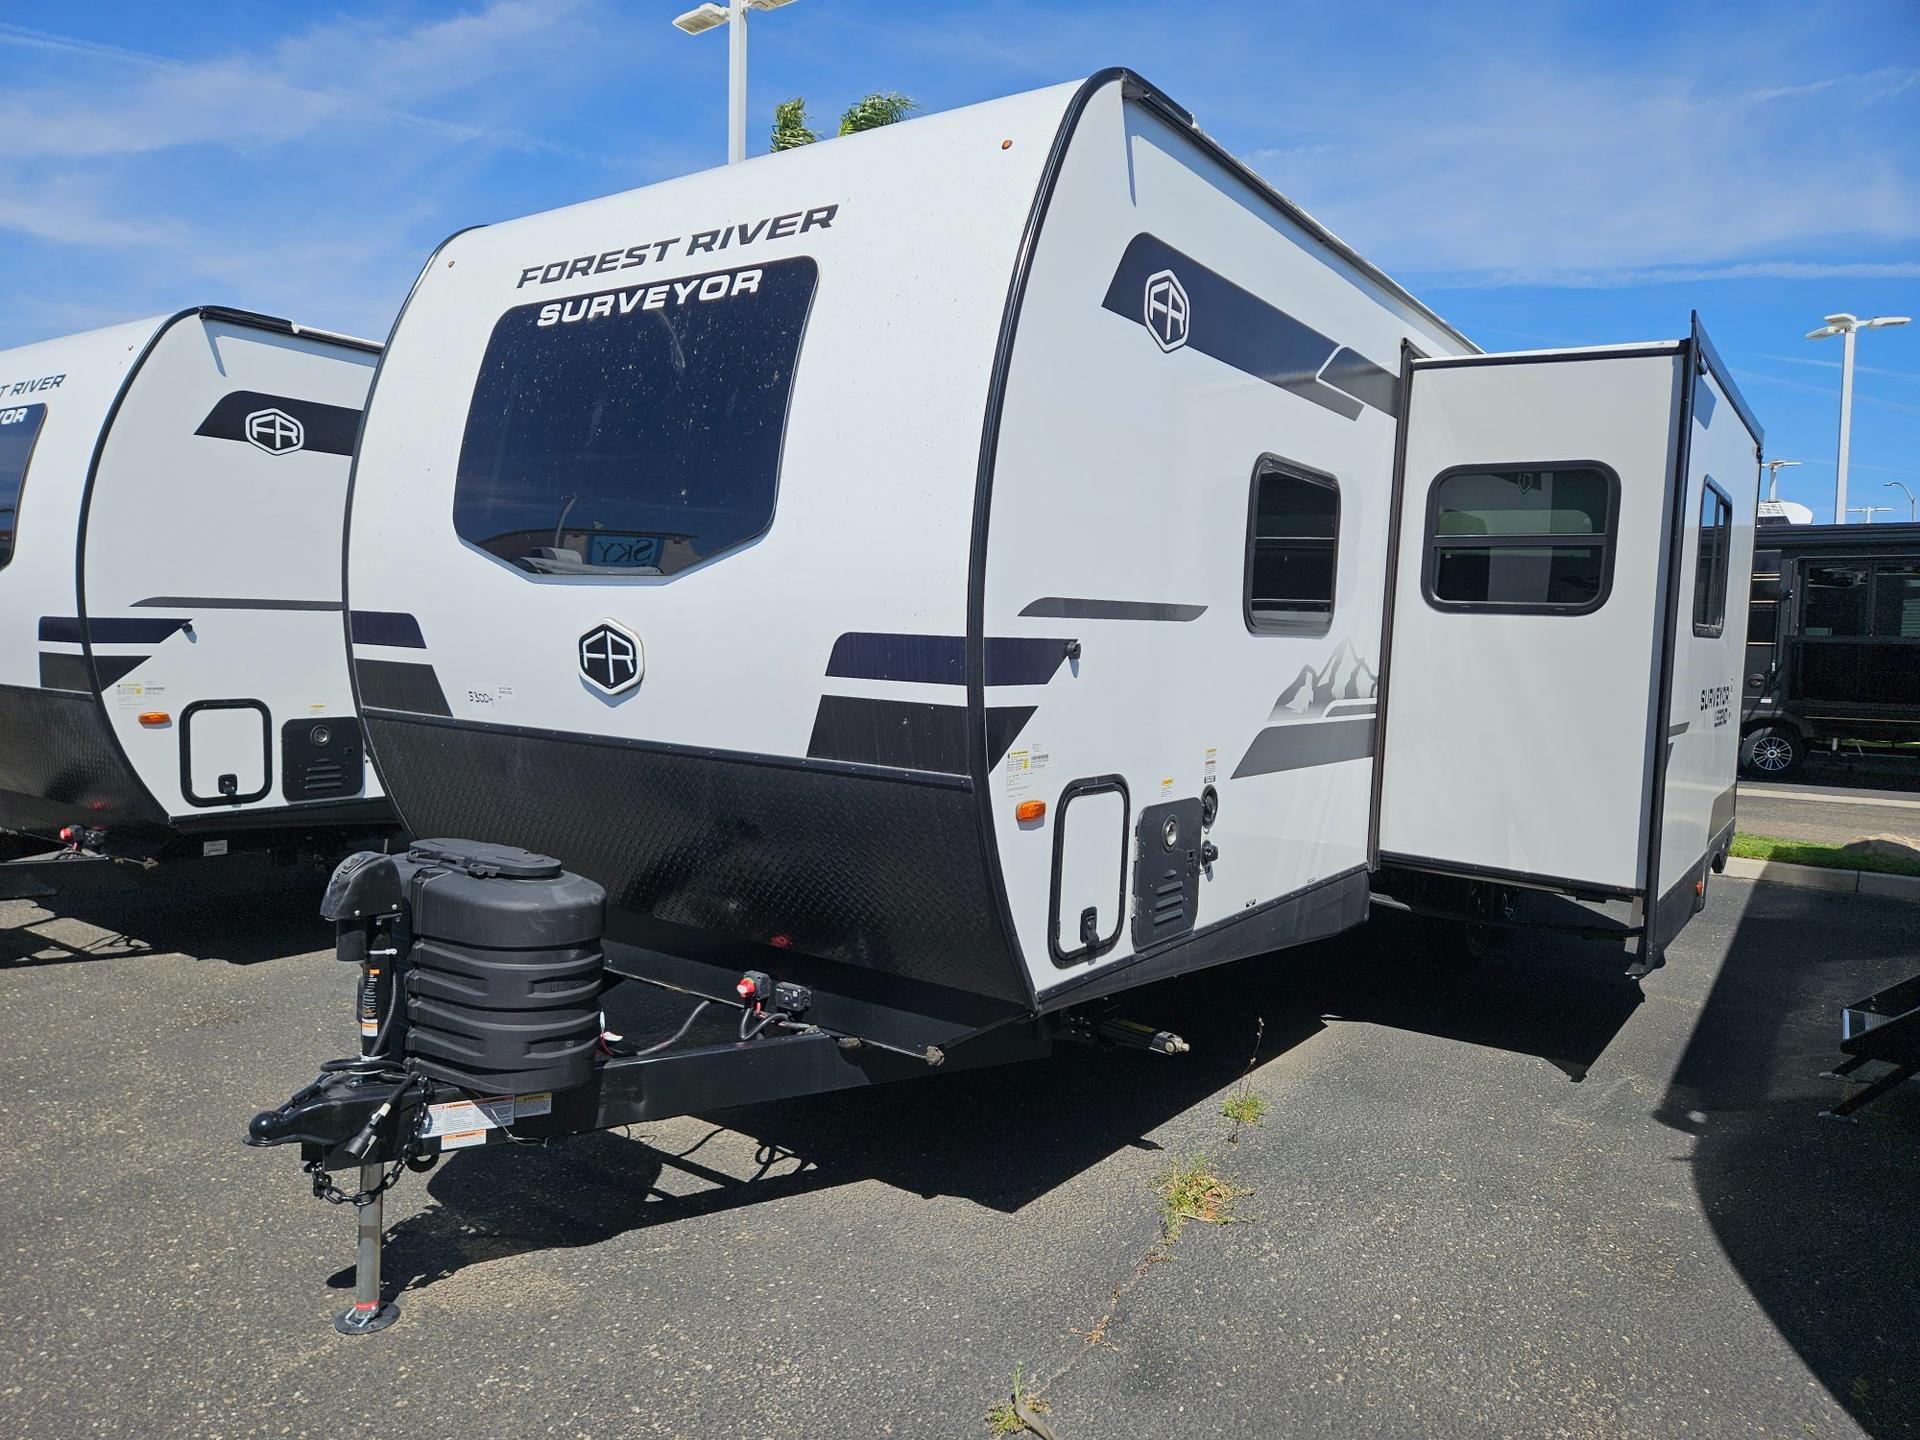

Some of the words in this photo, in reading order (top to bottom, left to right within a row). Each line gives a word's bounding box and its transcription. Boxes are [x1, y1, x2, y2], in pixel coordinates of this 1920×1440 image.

[516, 237, 681, 289] FOREST
[686, 203, 840, 257] RIVER
[537, 268, 763, 327] SURVEYOR
[10, 374, 67, 396] RIVER
